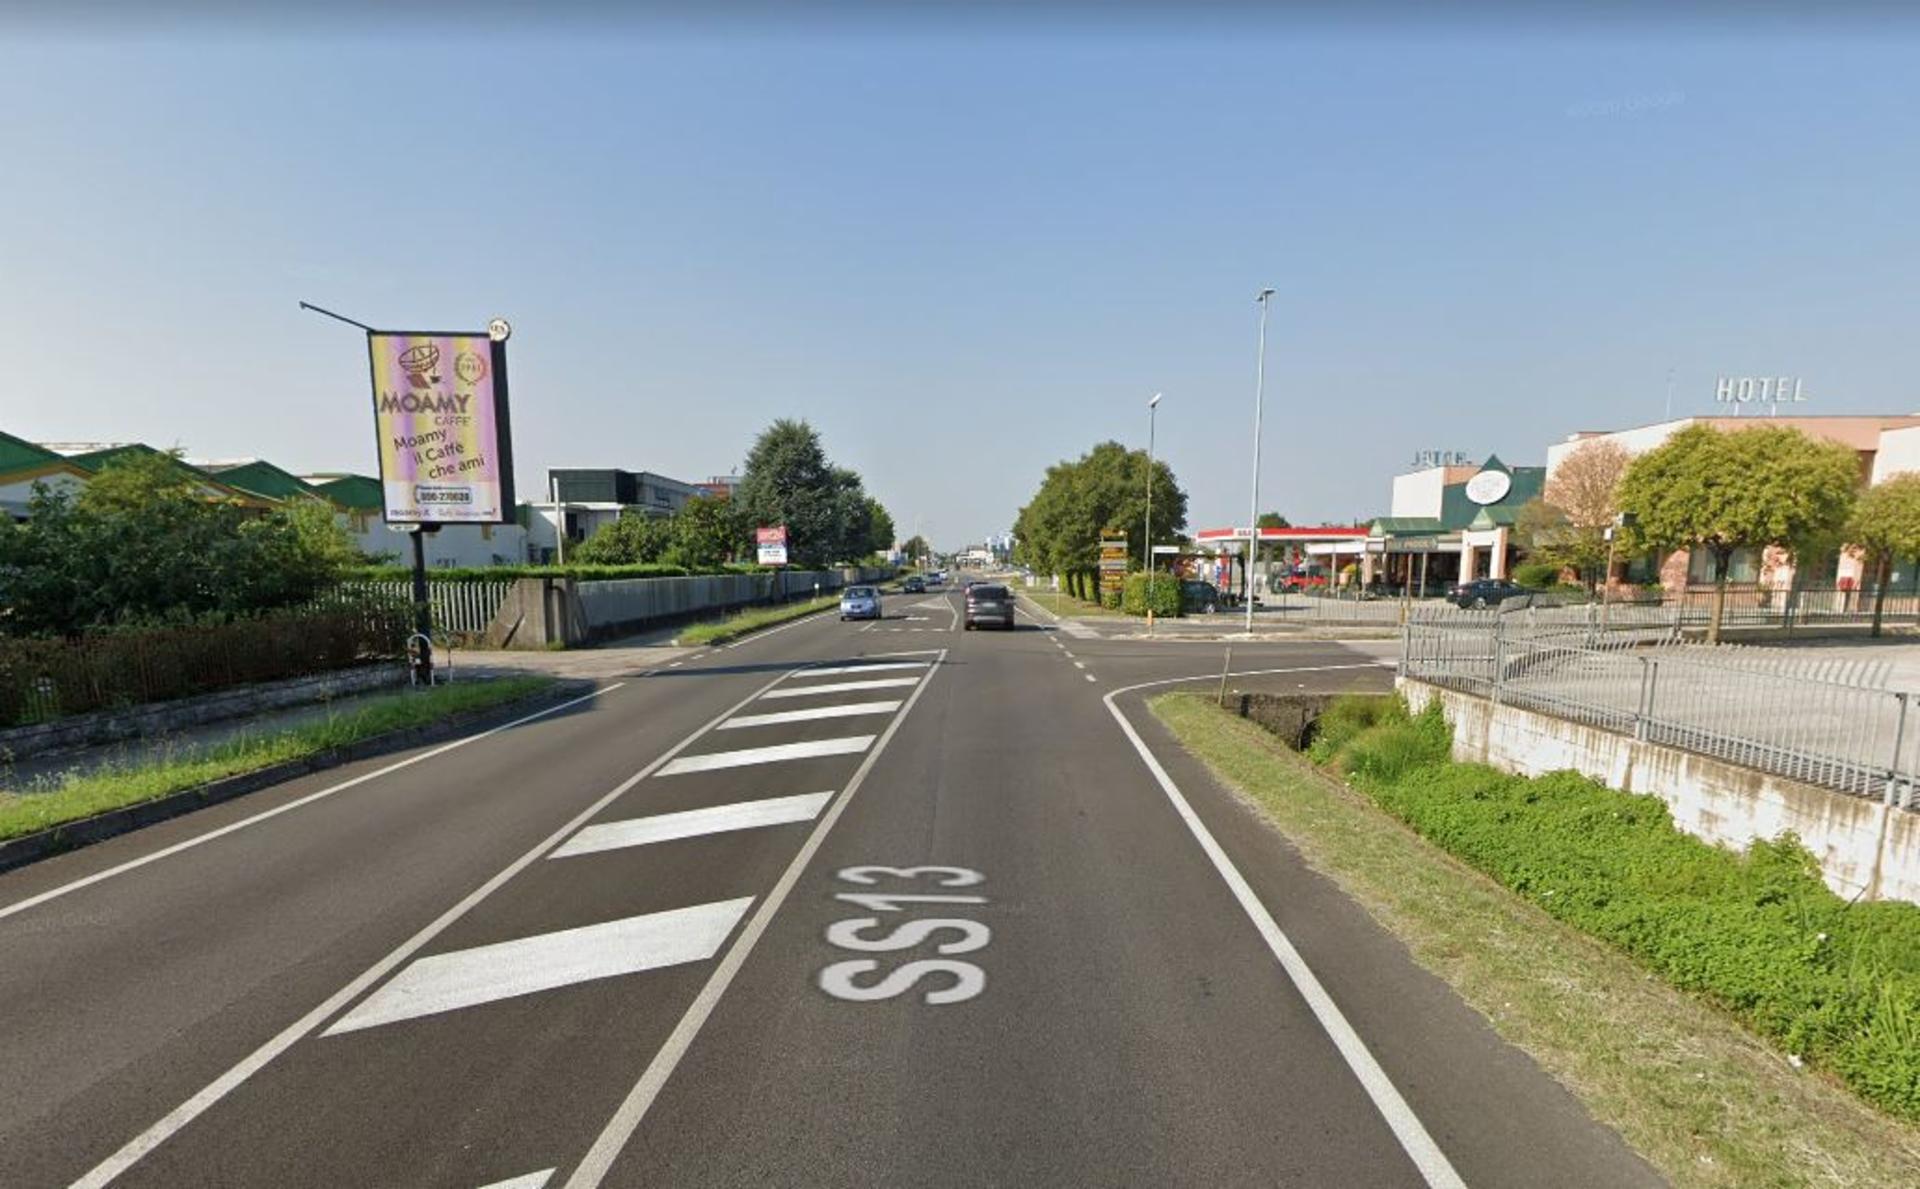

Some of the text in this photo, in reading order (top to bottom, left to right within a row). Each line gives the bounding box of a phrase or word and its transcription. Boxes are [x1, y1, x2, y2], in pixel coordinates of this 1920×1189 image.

[1716, 376, 1808, 402] HOTEL
[379, 392, 470, 413] MOAMY
[393, 429, 447, 451] Moamy
[429, 453, 485, 479] che ami
[820, 866, 990, 1004] SS13
